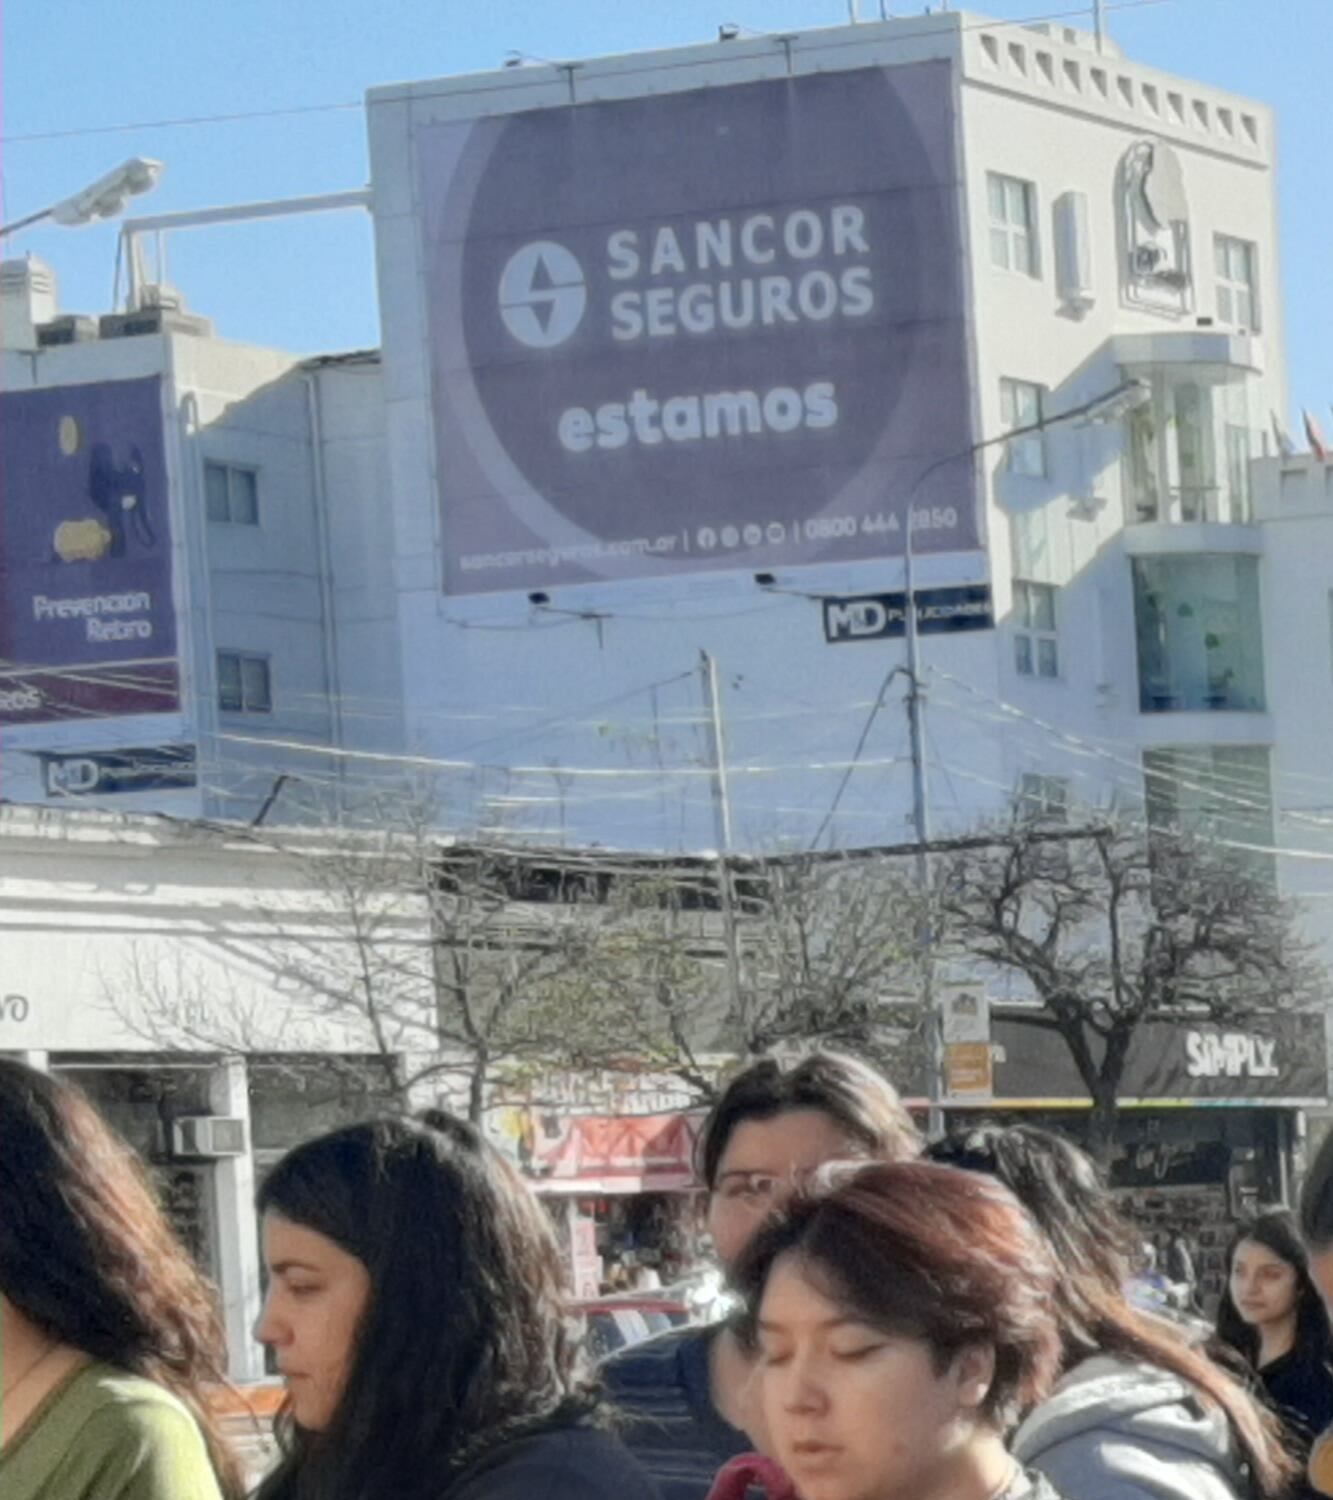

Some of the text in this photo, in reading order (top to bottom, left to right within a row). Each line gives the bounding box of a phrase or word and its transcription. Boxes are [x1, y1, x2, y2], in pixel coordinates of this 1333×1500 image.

[606, 204, 871, 281] SANCOR
[609, 266, 875, 342] SEGUROS
[557, 381, 839, 451] estamos
[805, 514, 857, 541] 0800
[828, 600, 887, 638] MD
